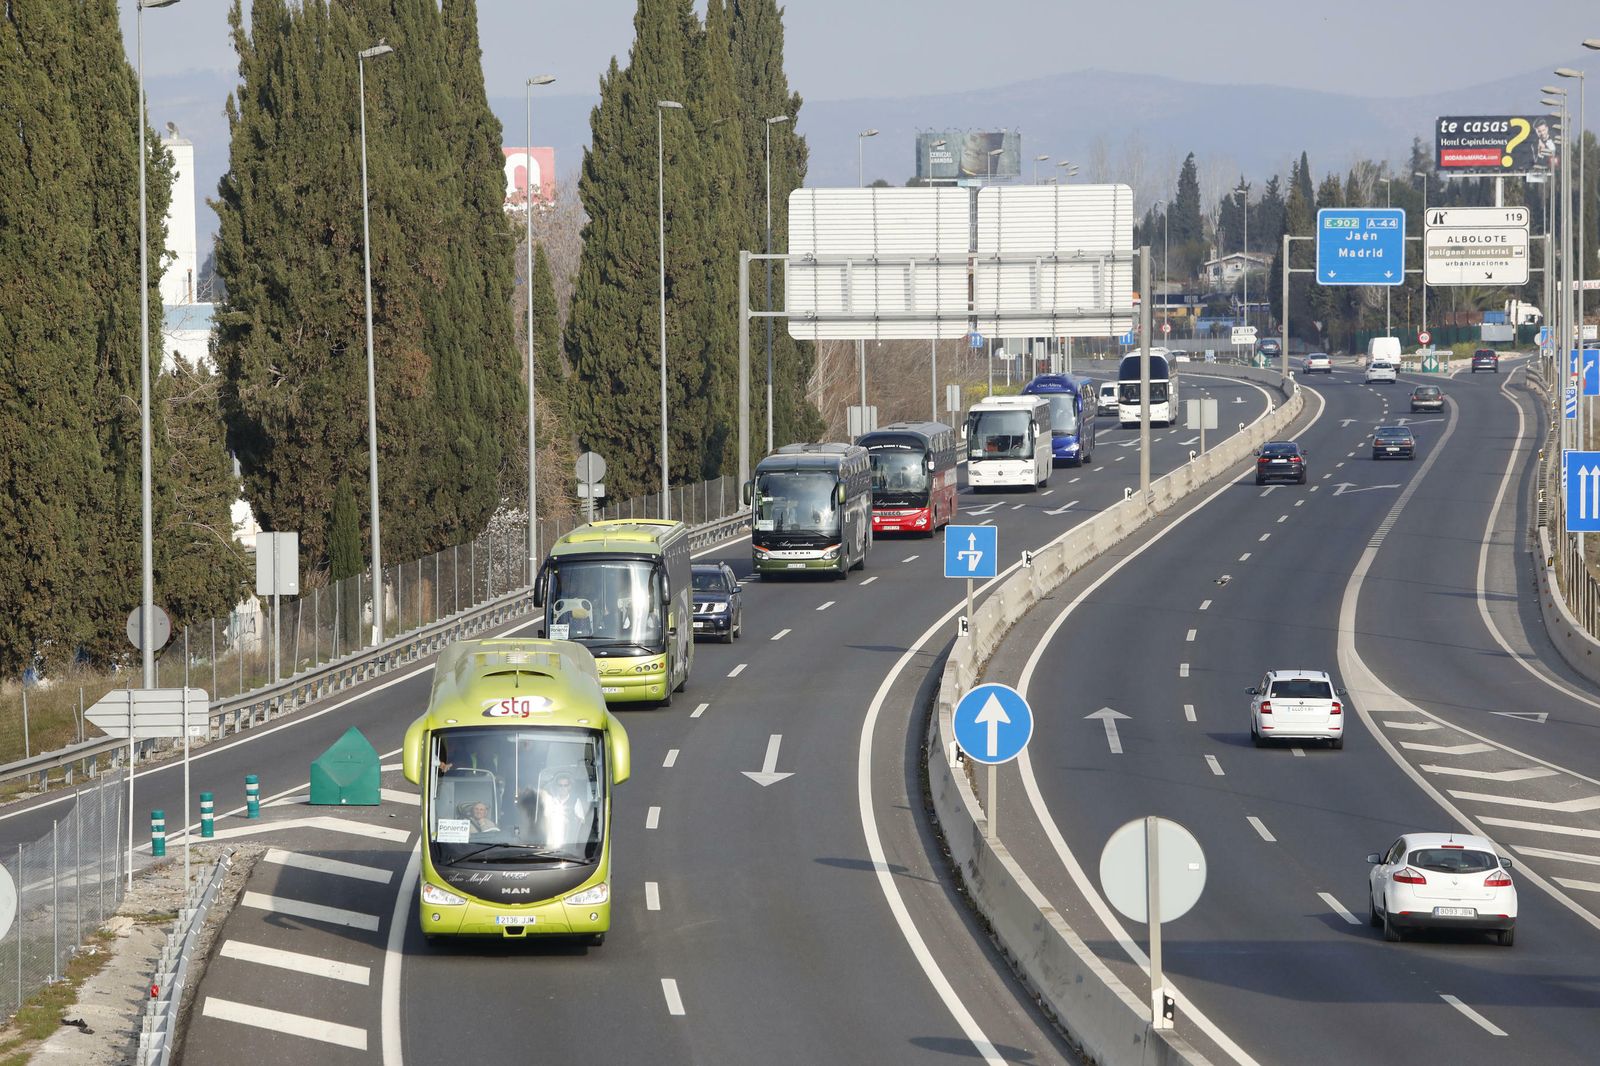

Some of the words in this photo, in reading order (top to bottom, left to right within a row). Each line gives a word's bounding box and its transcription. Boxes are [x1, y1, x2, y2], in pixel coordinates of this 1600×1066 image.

[1441, 120, 1457, 133] te
[1441, 138, 1460, 147] Hotel
[1461, 138, 1508, 147] Capitulaciones
[1505, 213, 1523, 222] 119
[1326, 219, 1357, 227] E-902
[1368, 219, 1396, 227] A-44
[1345, 231, 1377, 241] Jaén
[1447, 235, 1507, 243] ALBOLOTE
[1338, 247, 1383, 258] Madrid
[1429, 247, 1466, 256] polígono
[1468, 247, 1509, 255] industrial
[501, 697, 529, 718] stg
[439, 823, 469, 832] Poniente
[501, 916, 518, 924] 2136
